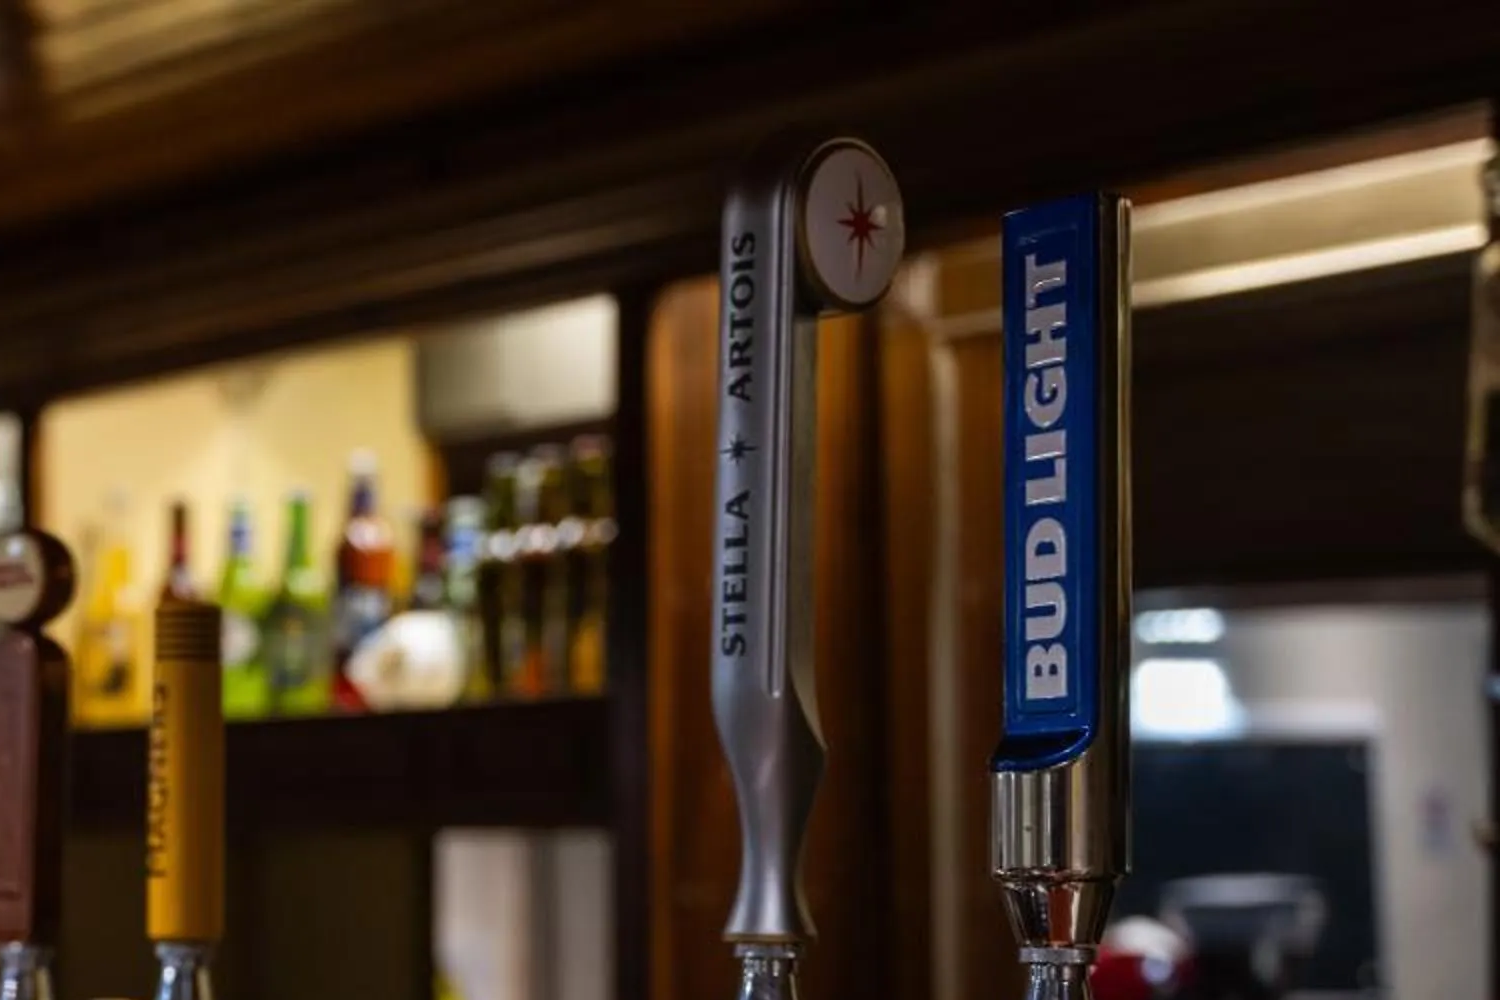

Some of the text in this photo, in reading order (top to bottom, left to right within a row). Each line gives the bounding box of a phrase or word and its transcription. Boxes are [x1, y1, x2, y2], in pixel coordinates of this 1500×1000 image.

[719, 229, 757, 658] STELLA ARTOIS
[1023, 253, 1069, 700] BUD LIGHT
